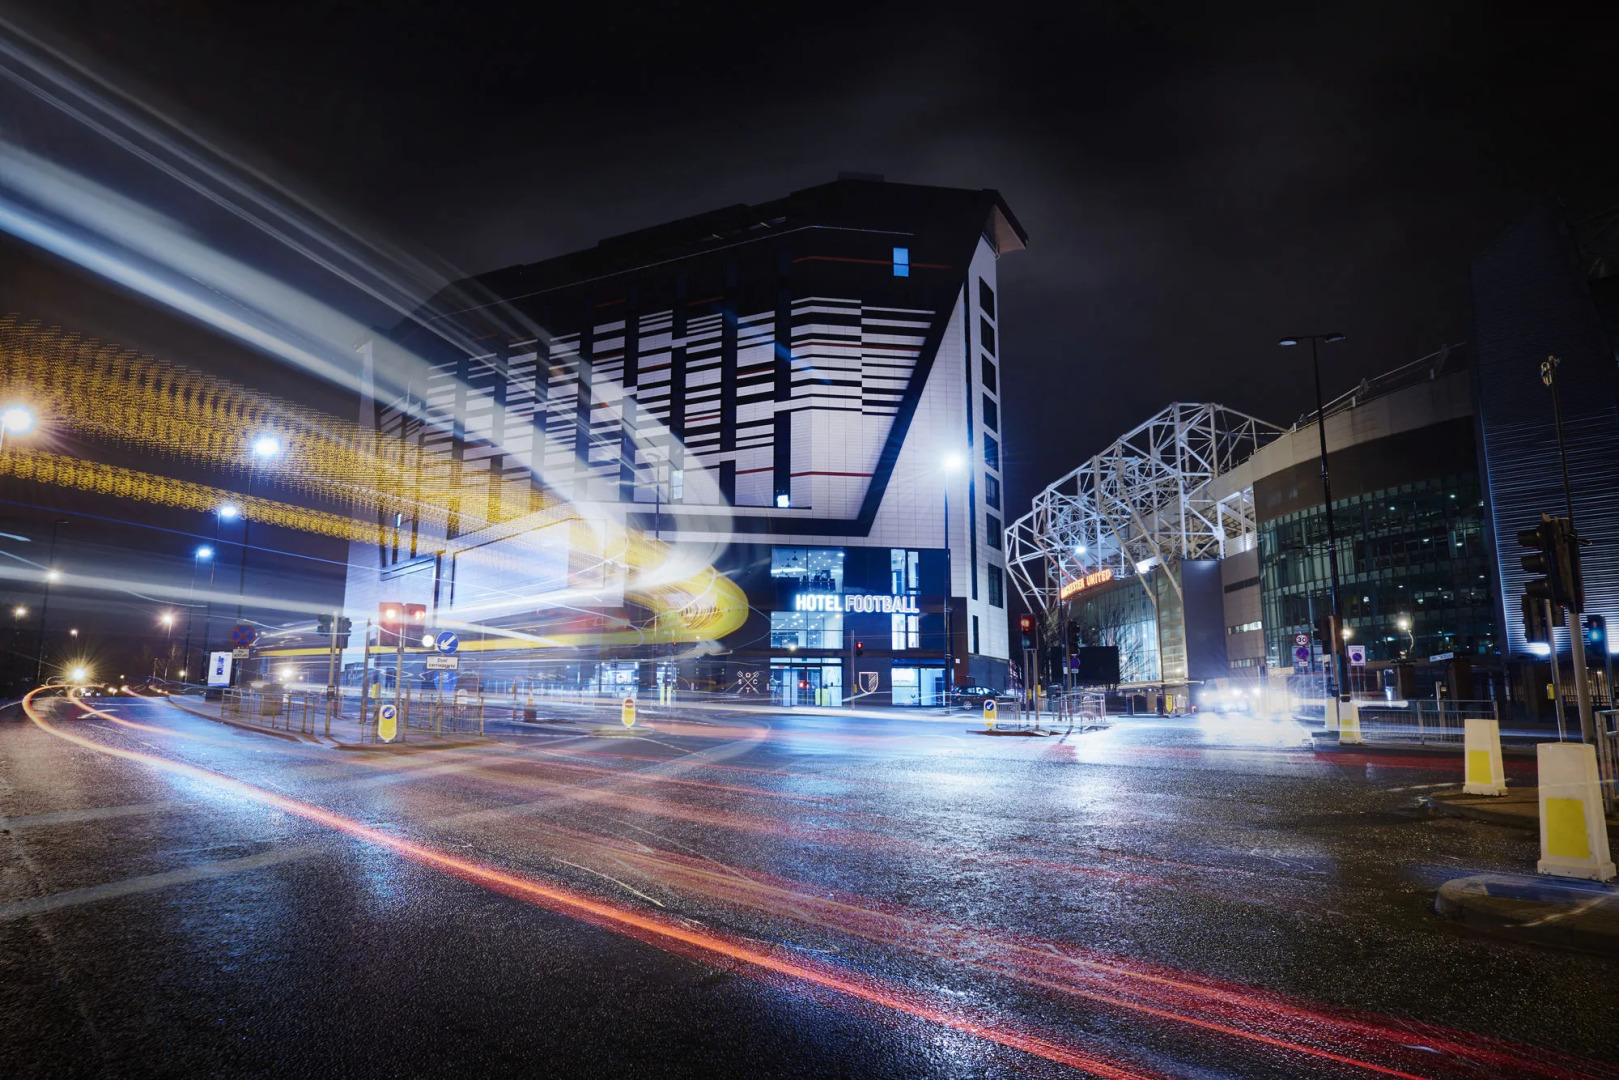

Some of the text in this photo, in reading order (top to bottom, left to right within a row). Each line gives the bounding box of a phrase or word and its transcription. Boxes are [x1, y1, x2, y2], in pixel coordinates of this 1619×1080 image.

[1086, 567, 1111, 587] UNITED
[795, 594, 920, 614] HOTEL FOOTBALL
[1297, 636, 1307, 644] 30
